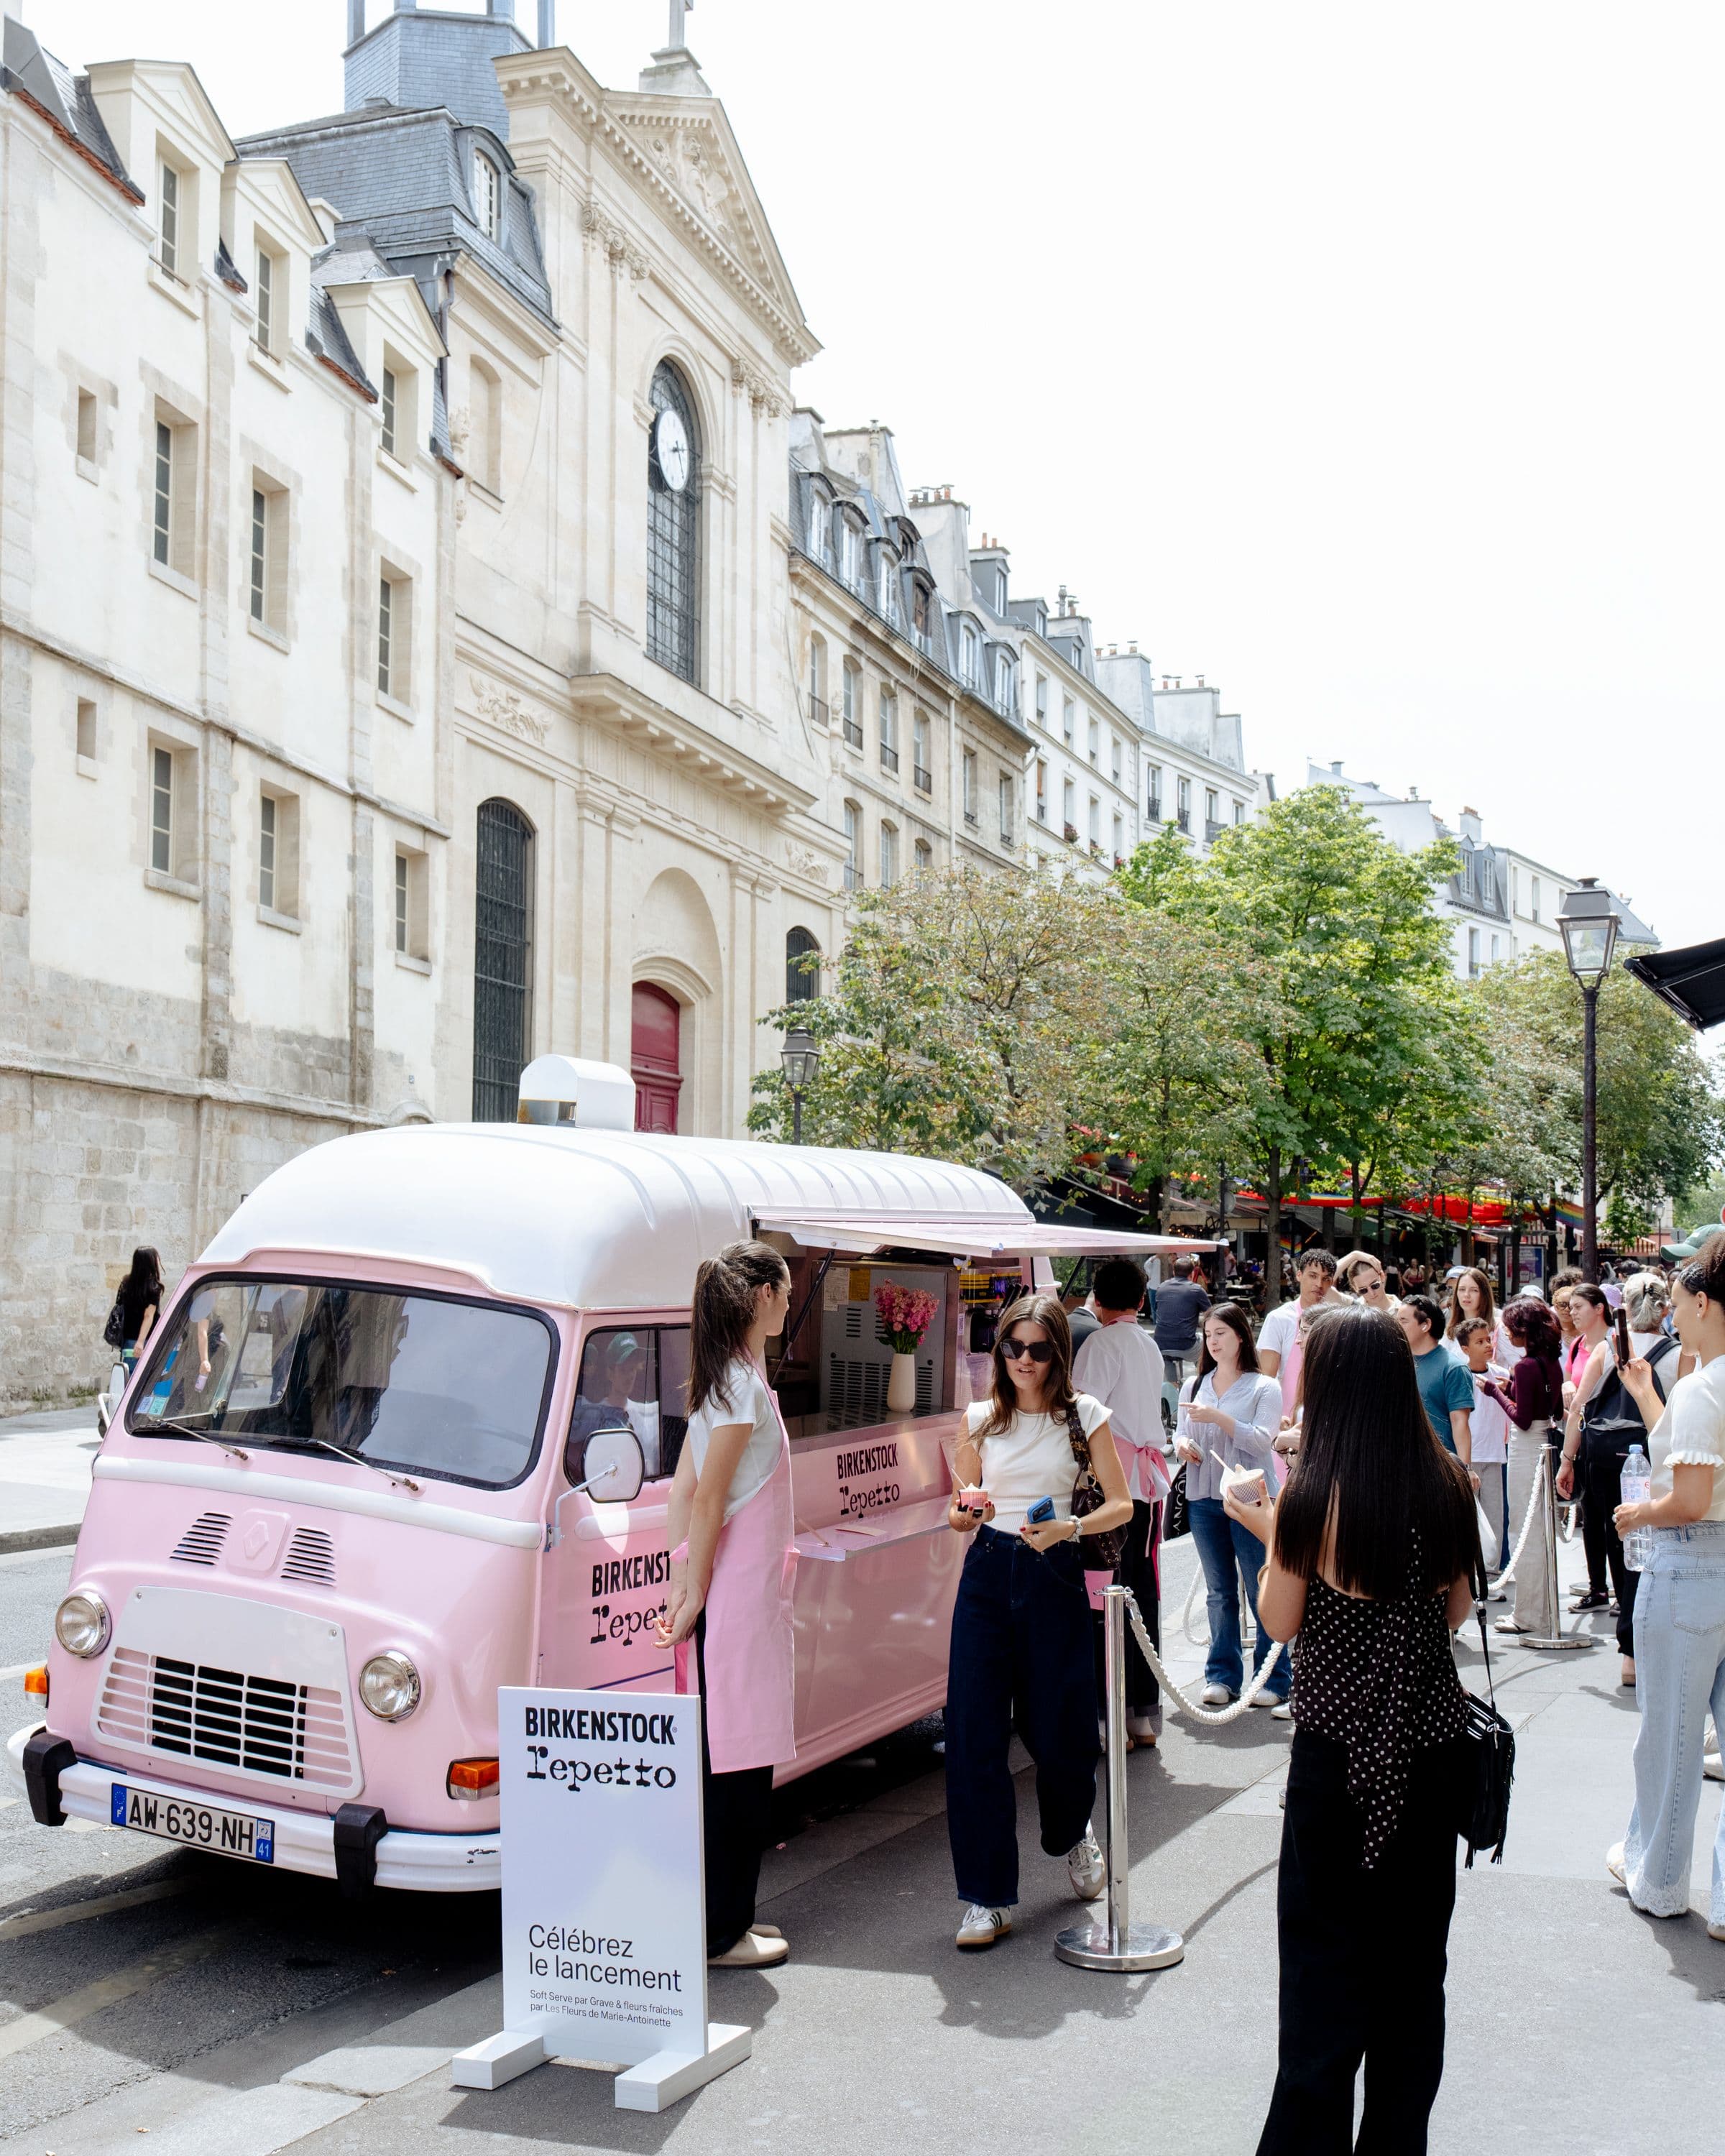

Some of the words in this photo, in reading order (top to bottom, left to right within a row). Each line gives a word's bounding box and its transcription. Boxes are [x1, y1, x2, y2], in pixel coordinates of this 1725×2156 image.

[837, 1442, 898, 1479] BIRKENSTOCK
[840, 1480, 900, 1519] repetto
[592, 1550, 670, 1597] BIRKENST
[590, 1598, 667, 1646] repet
[527, 1745, 676, 1792] repetto
[129, 1795, 254, 1853] AW-639-NH
[258, 1842, 270, 1858] 41
[529, 1925, 633, 1958] Célébrez
[529, 1951, 548, 1976] le
[556, 1954, 682, 1991] lancement
[530, 1989, 547, 2000] Soft
[549, 1991, 573, 2003] Serve
[574, 1996, 588, 2005] par
[589, 1996, 614, 2007] Grave
[616, 1999, 622, 2009] &
[624, 2001, 647, 2012] fleurs
[649, 2004, 684, 2017] fraîches
[530, 2003, 543, 2012] par
[546, 2003, 560, 2014] Les
[561, 2005, 586, 2017] Fleurs
[588, 2009, 599, 2018] de
[601, 2010, 671, 2027] Marie-Antoinette
